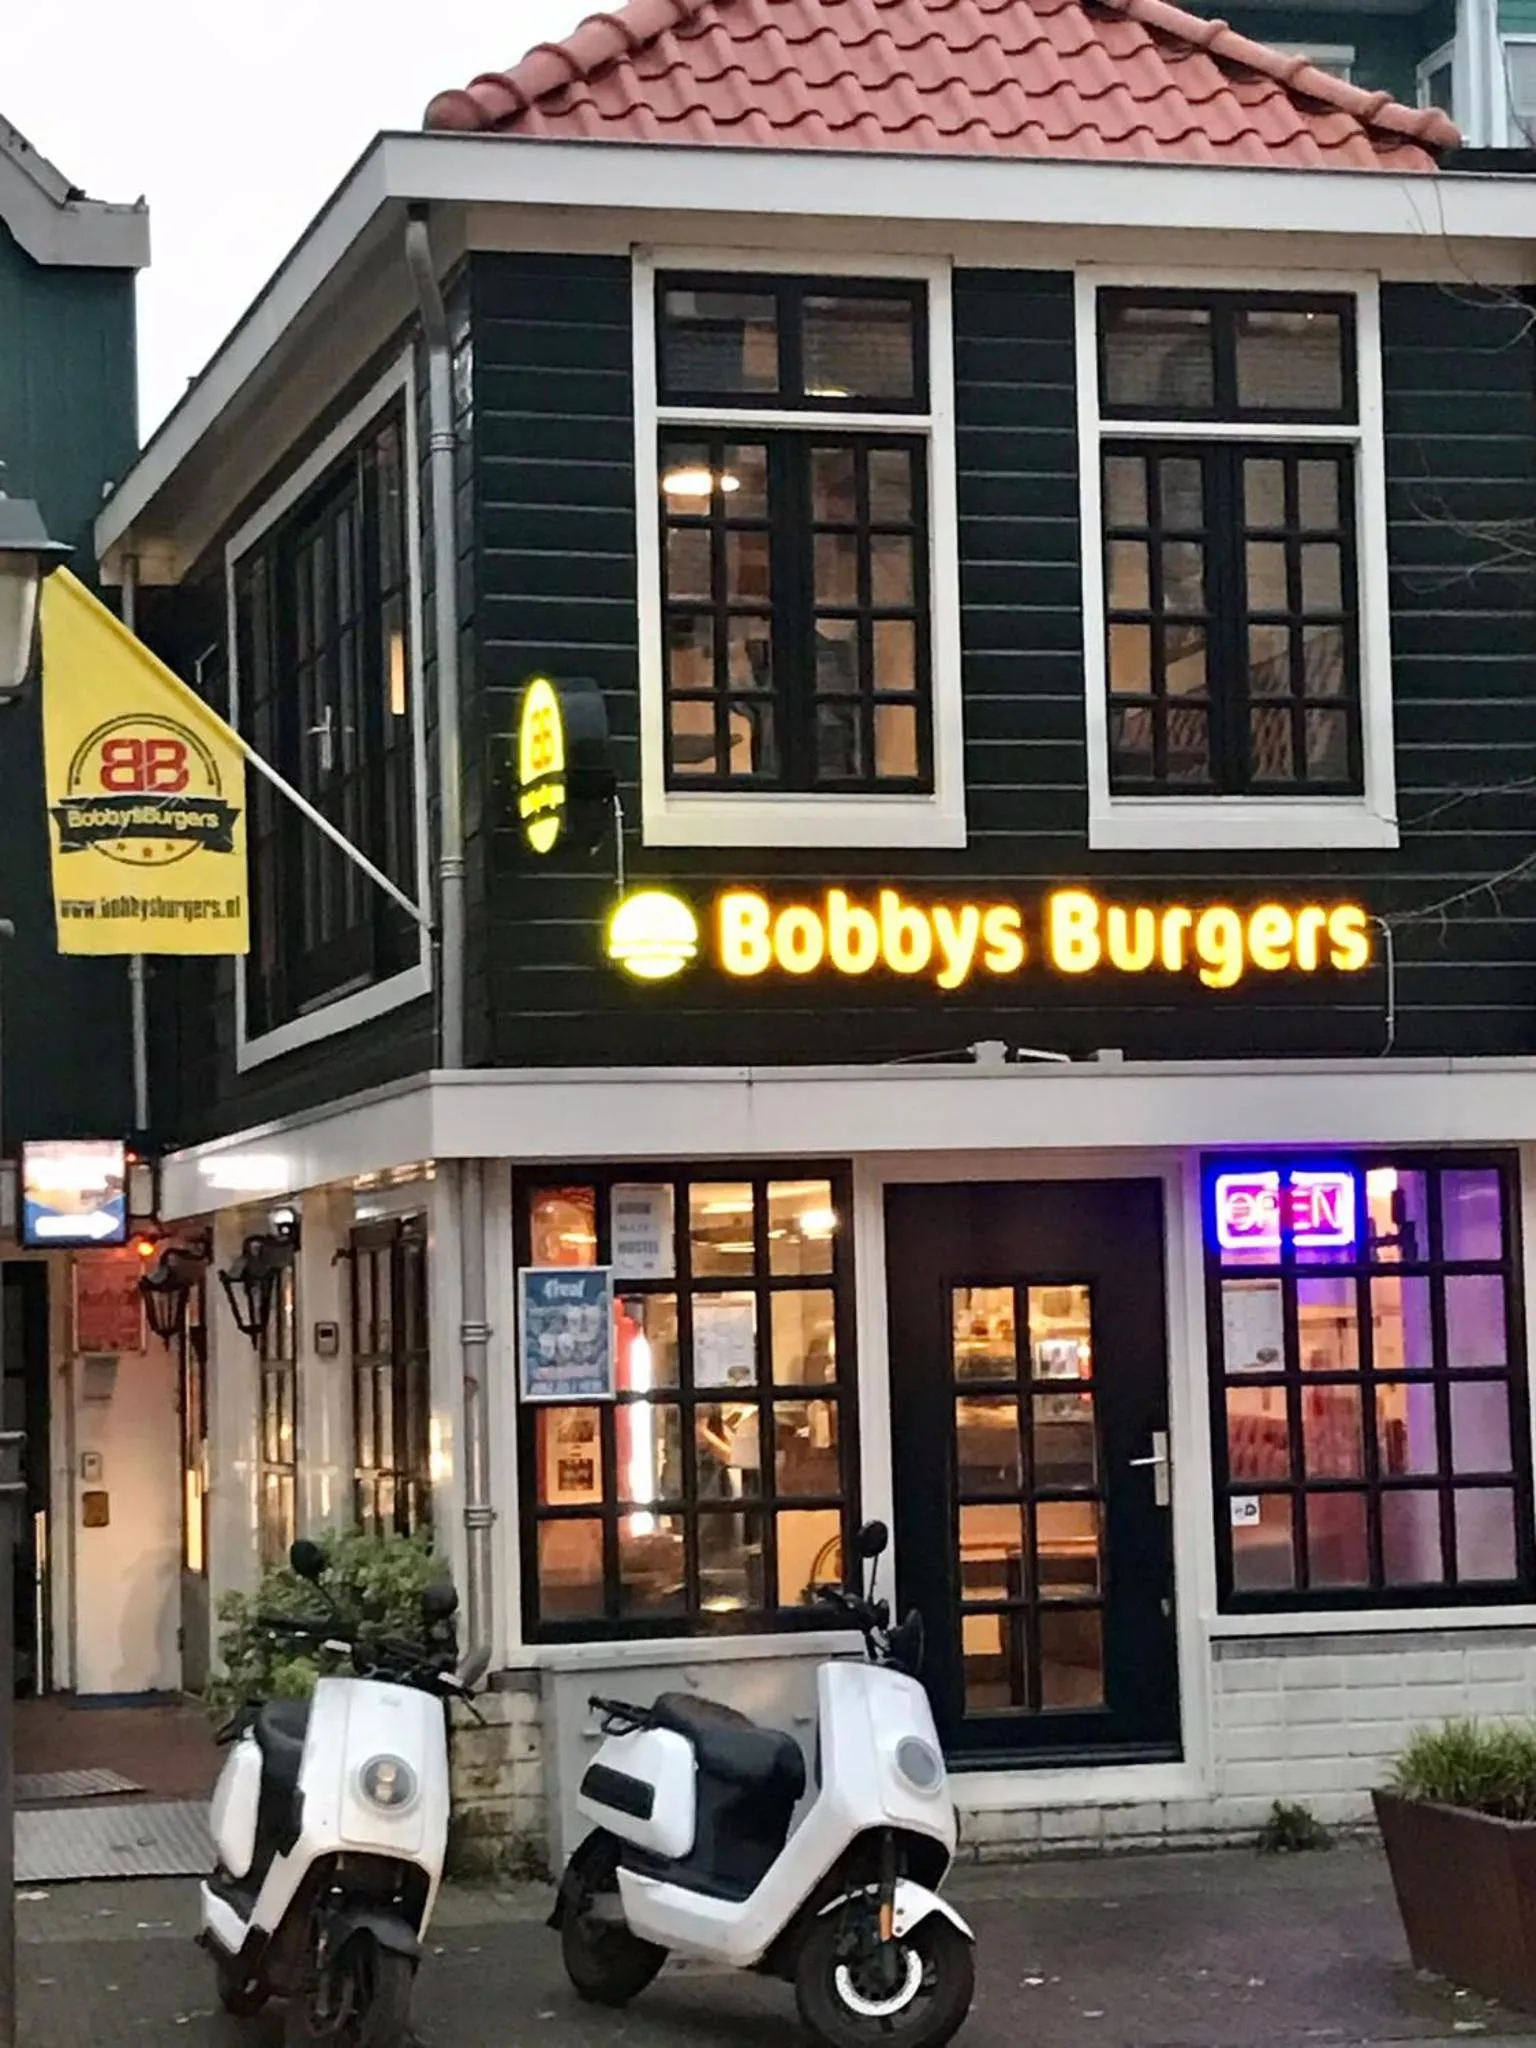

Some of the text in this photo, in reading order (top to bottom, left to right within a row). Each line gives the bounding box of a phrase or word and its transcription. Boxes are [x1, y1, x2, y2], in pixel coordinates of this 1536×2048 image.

[60, 895, 241, 923] www.bobbysburgers.nl
[719, 888, 1370, 990] Bobbys Burgers
